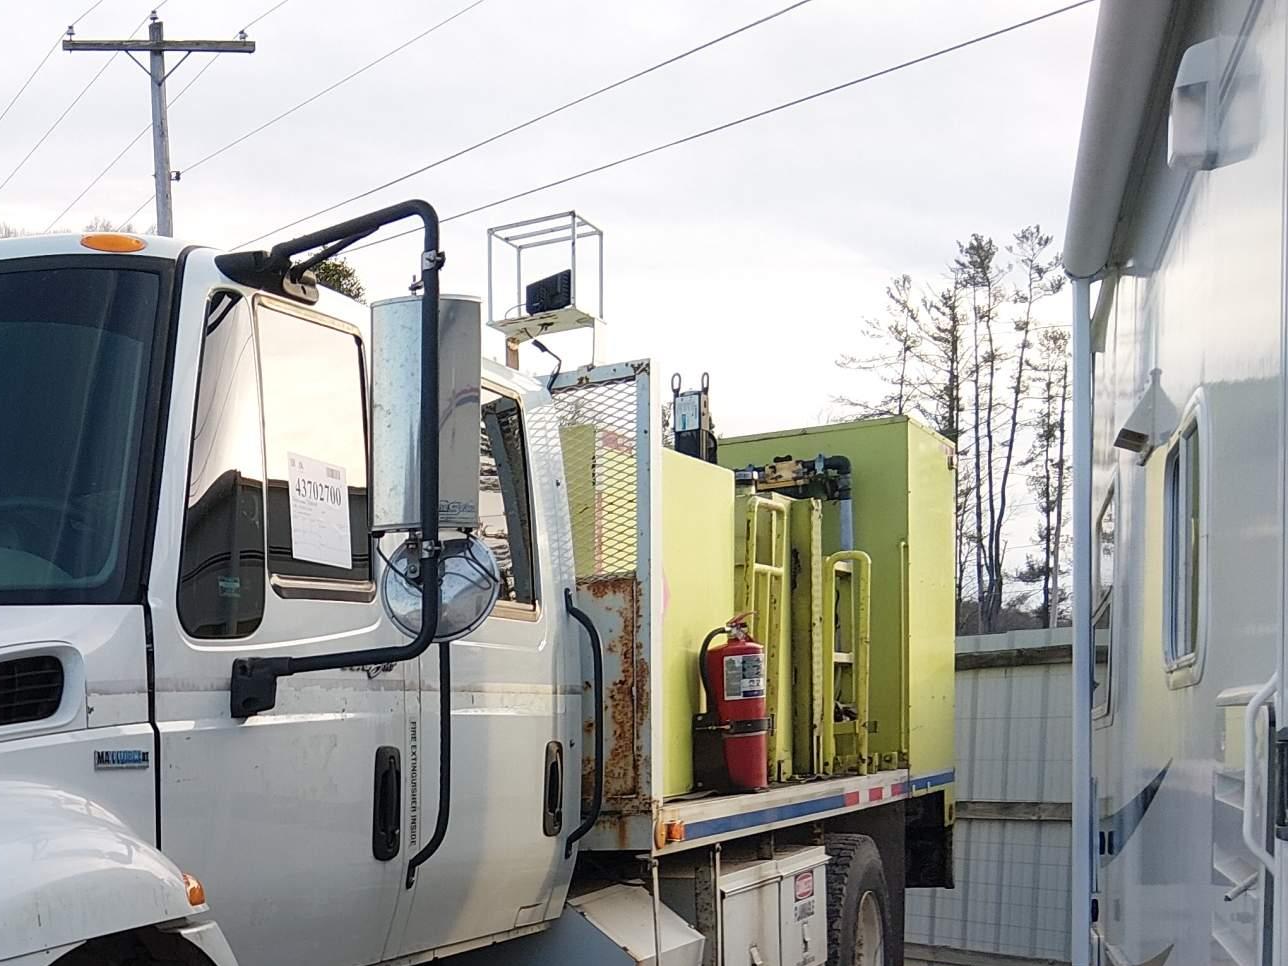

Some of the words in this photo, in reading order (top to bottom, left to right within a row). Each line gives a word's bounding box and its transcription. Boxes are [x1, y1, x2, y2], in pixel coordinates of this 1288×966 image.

[296, 477, 341, 506] 43702700
[409, 721, 418, 742] FIRE
[409, 744, 418, 812] EXTINGUISHER
[409, 815, 418, 846] INSIDE
